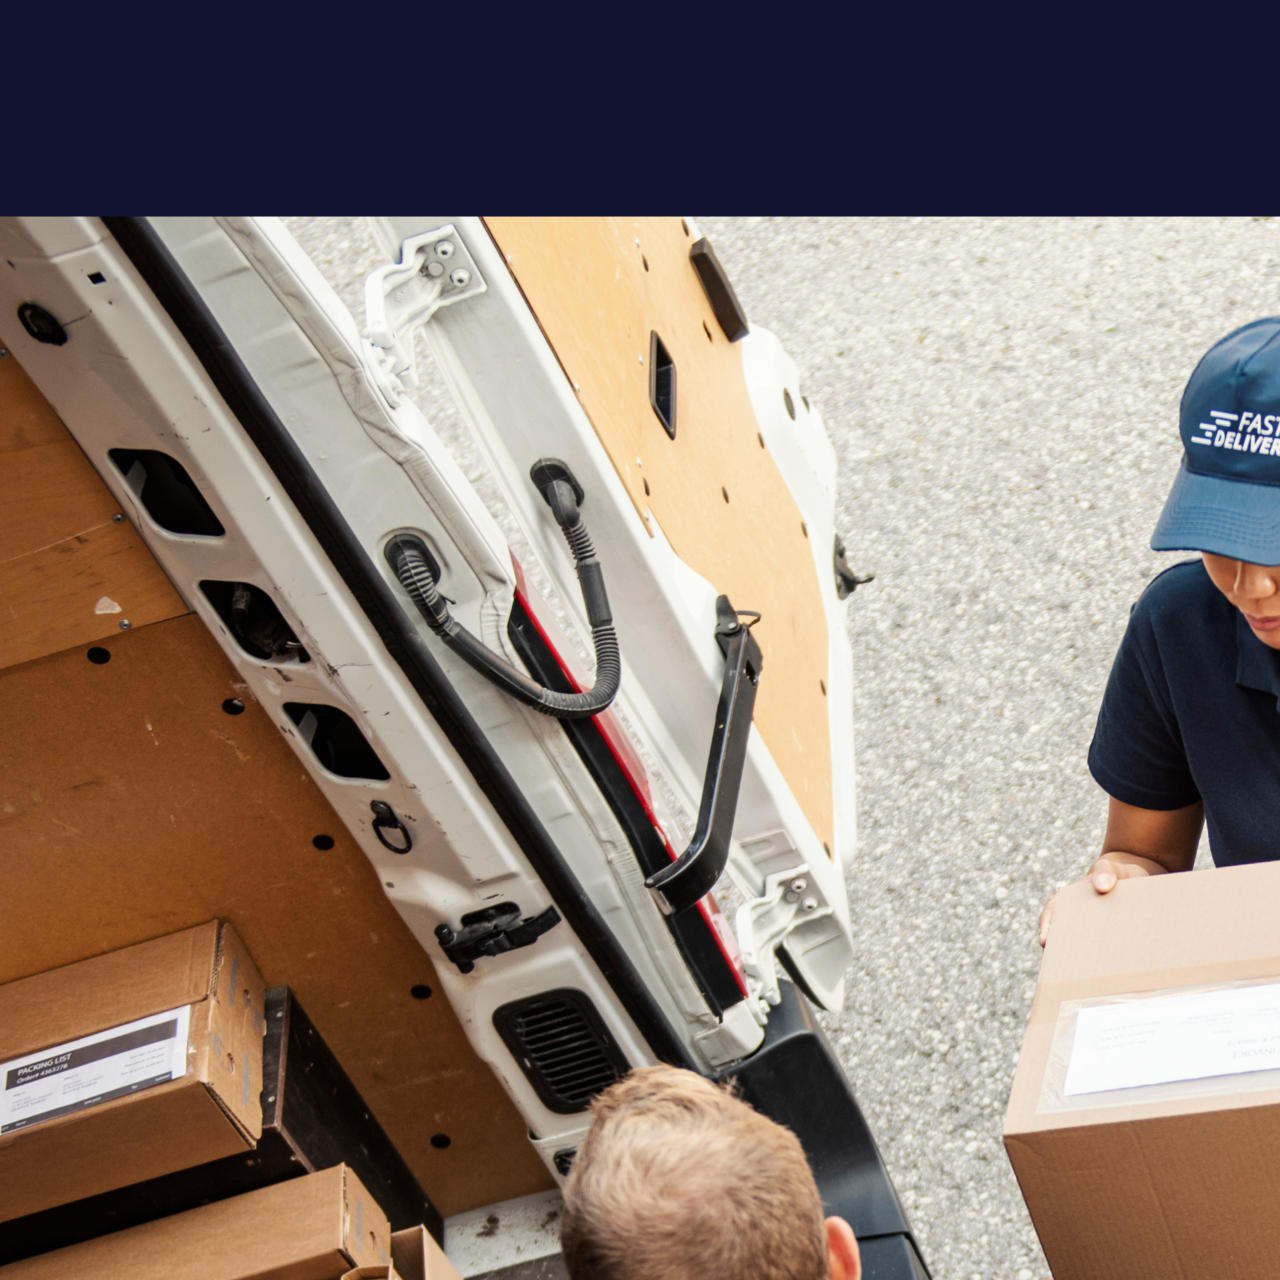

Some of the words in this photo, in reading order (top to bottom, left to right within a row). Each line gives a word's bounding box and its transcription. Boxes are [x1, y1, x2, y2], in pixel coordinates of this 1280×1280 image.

[1229, 1046, 1276, 1059] INVOICE
[16, 1072, 39, 1084] Order#
[40, 1063, 68, 1076] 4363278
[17, 1059, 53, 1076] PACKING
[54, 1053, 72, 1064] LIST
